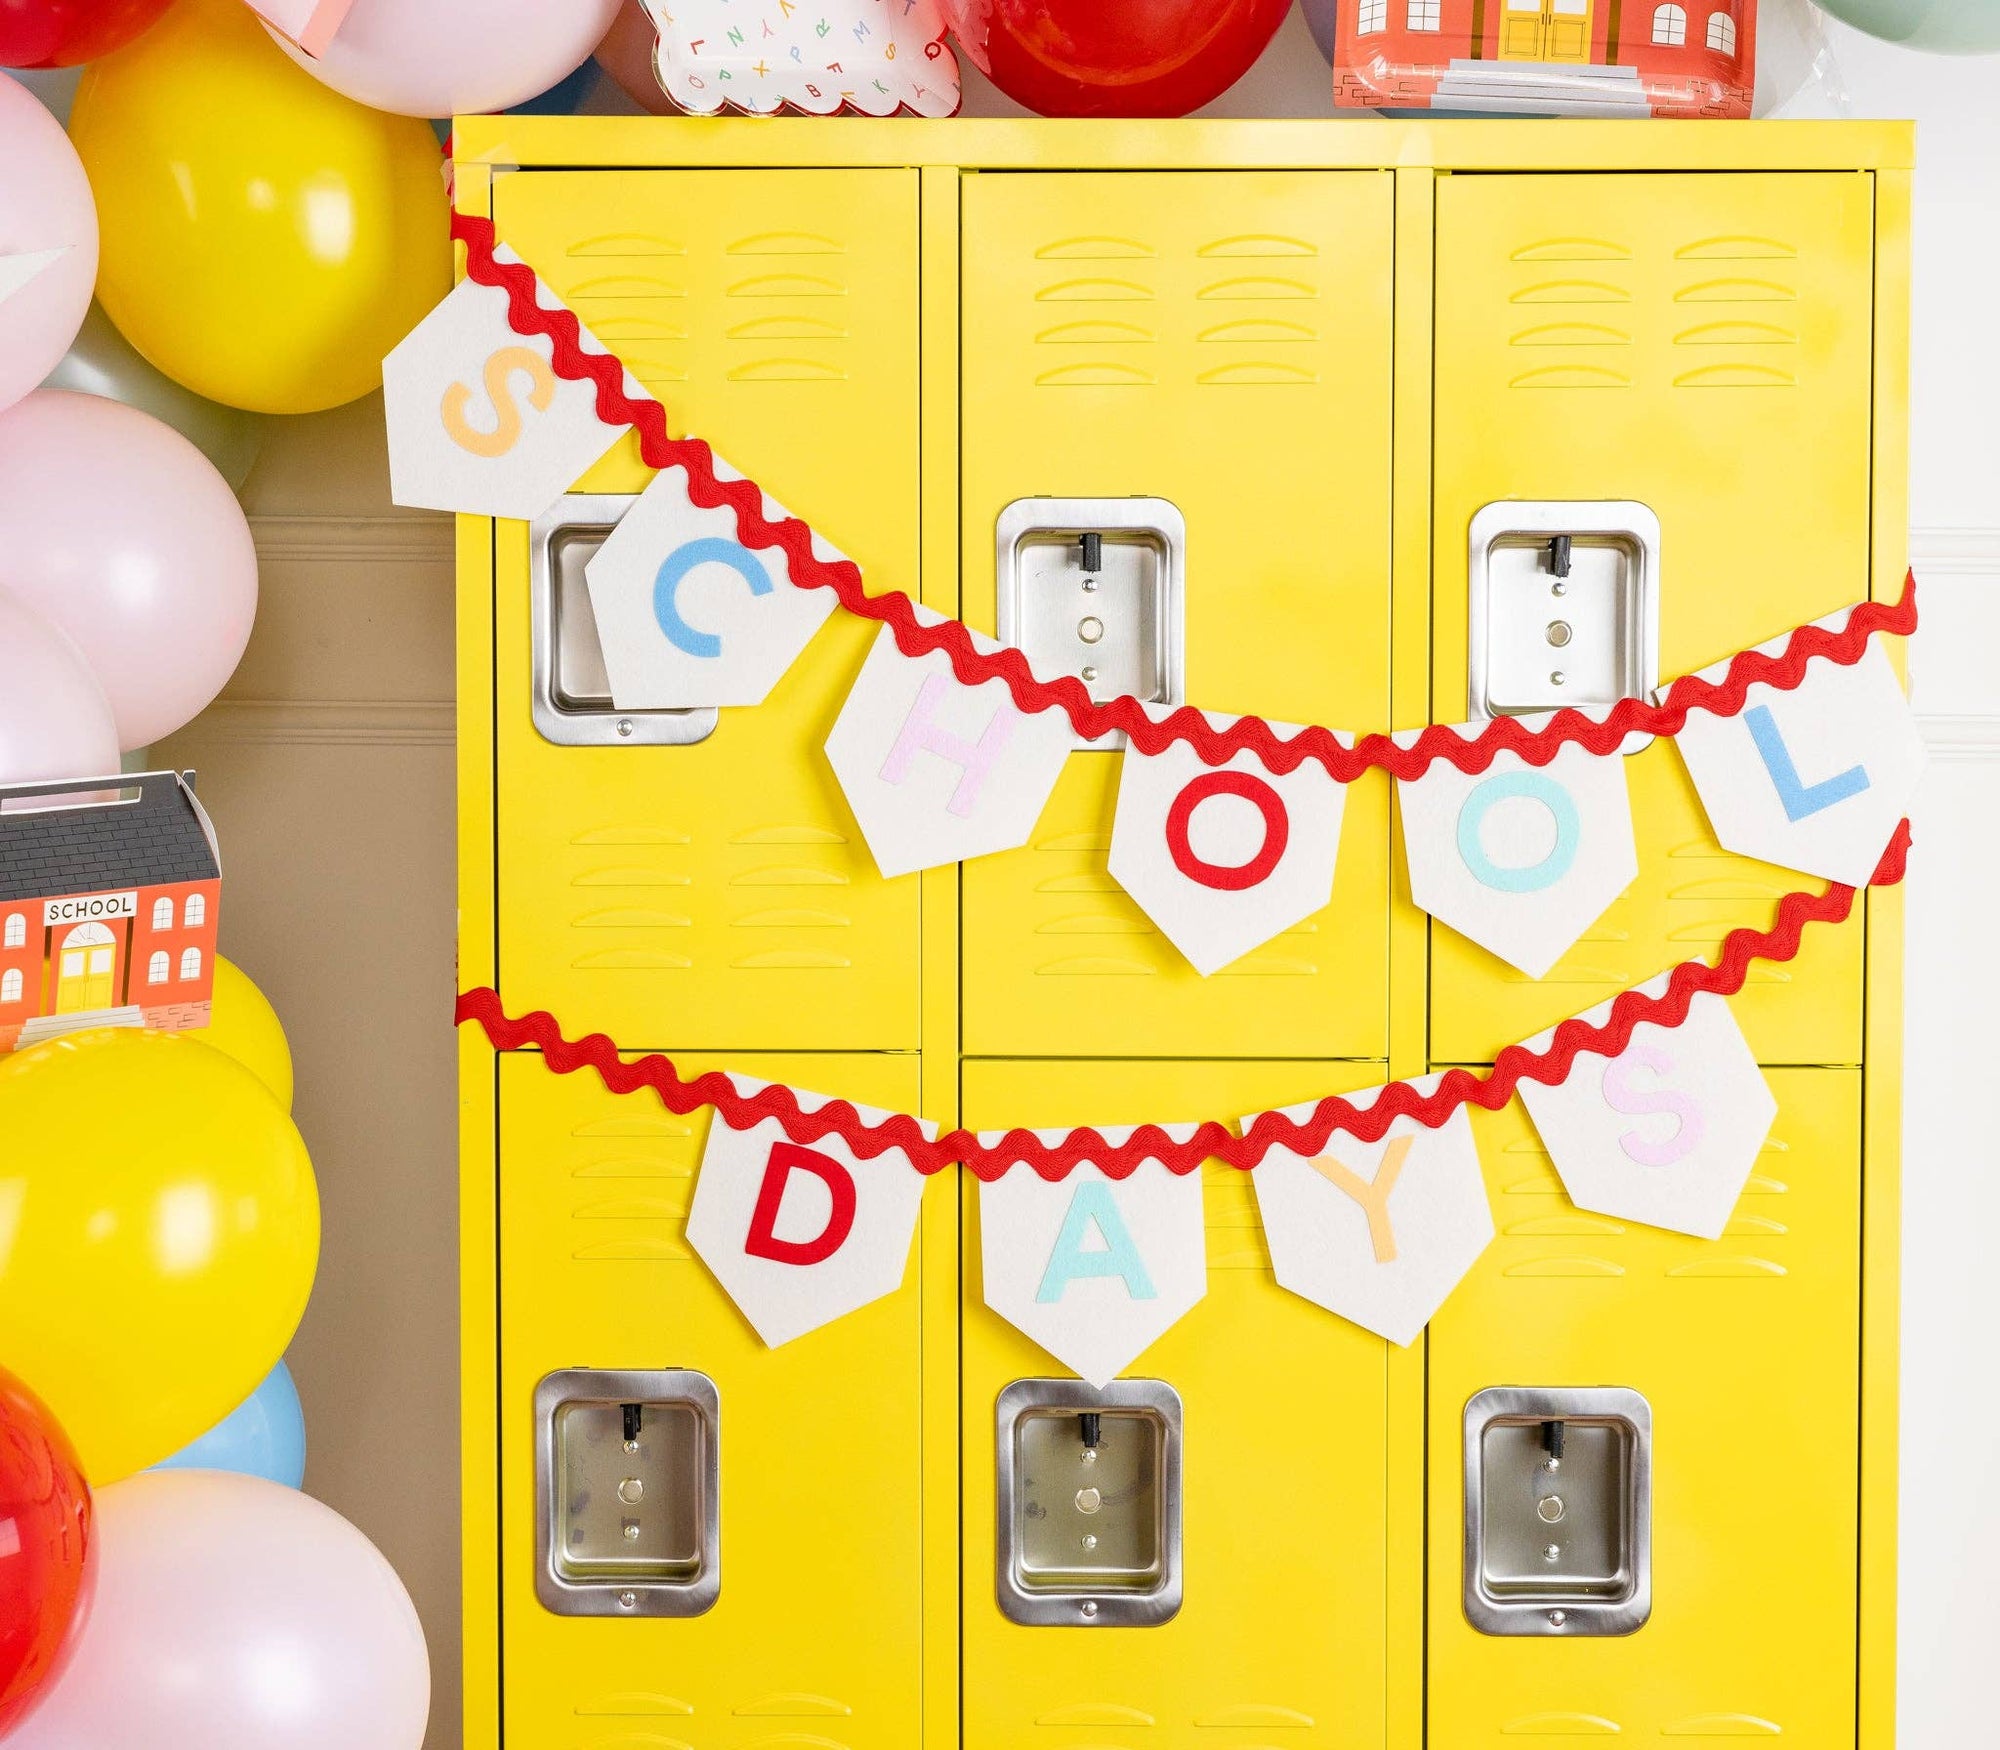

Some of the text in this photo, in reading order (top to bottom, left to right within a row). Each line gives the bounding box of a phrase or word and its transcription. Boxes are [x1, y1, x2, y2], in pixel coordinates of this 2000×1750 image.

[885, 43, 896, 61] S
[924, 41, 941, 60] Q
[826, 62, 843, 73] F
[805, 84, 822, 97] B
[441, 346, 1870, 894] SCHOOL
[49, 897, 132, 920] SCHOOL
[745, 1045, 1700, 1303] DAYS
